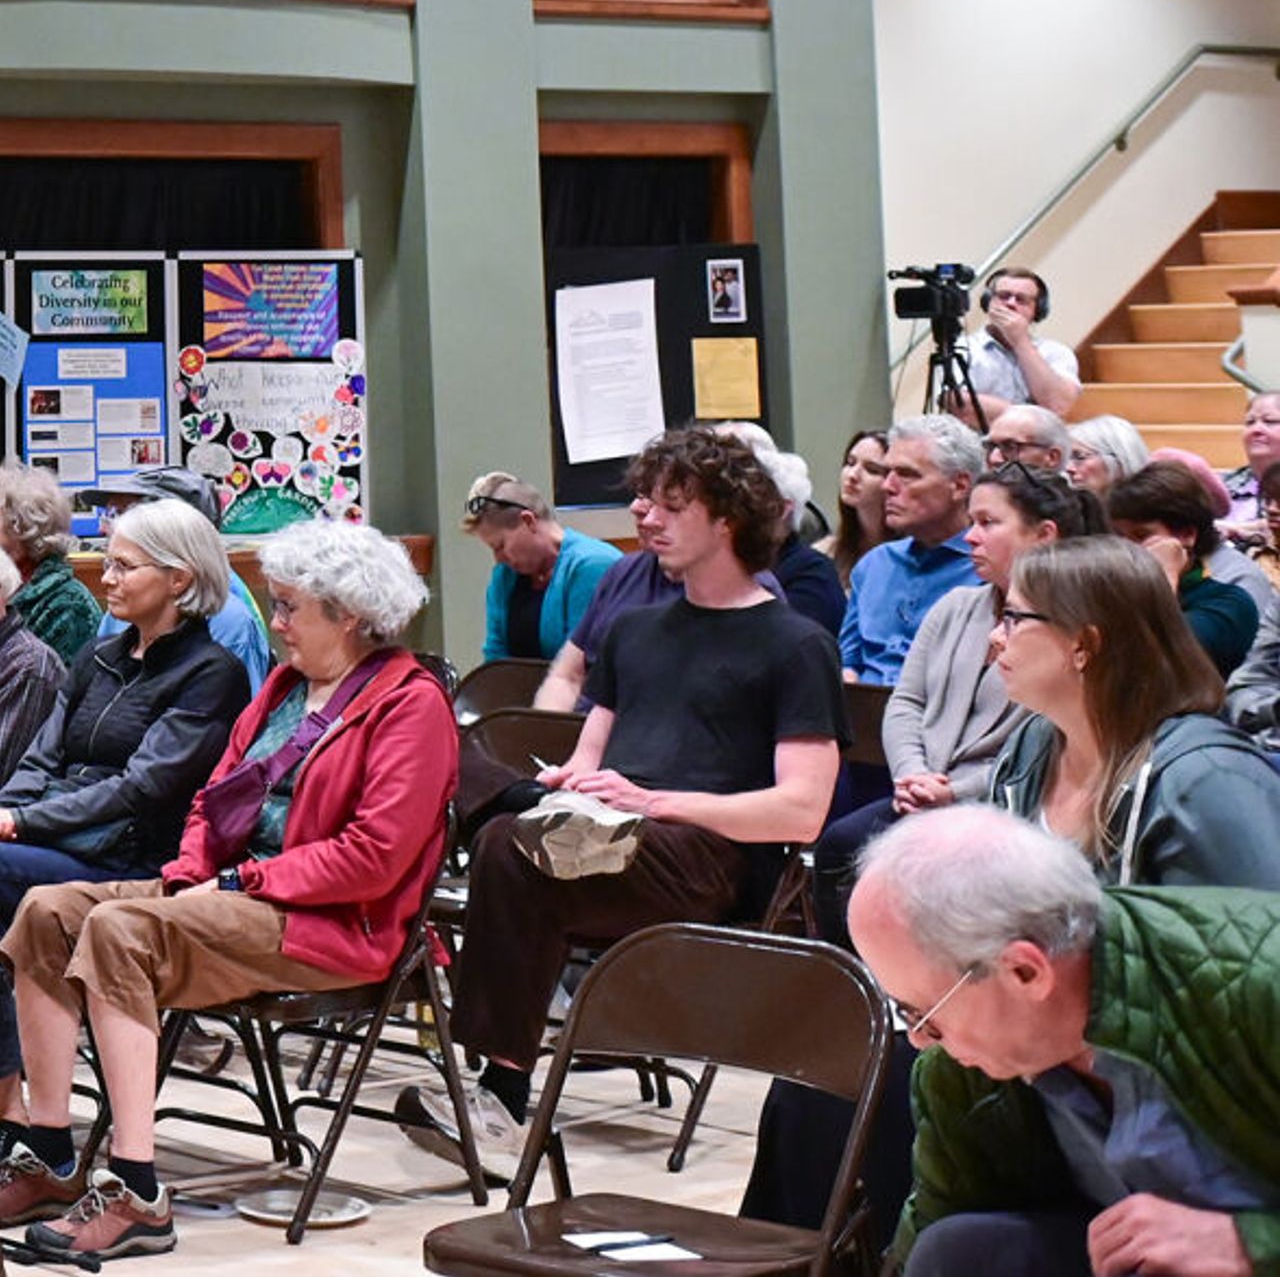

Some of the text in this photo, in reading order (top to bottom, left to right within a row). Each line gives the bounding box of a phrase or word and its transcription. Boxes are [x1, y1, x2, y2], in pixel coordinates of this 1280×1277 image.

[51, 274, 130, 292] Celebrating
[39, 294, 143, 310] Diversity in our
[51, 313, 135, 328] Community
[202, 368, 245, 390] What
